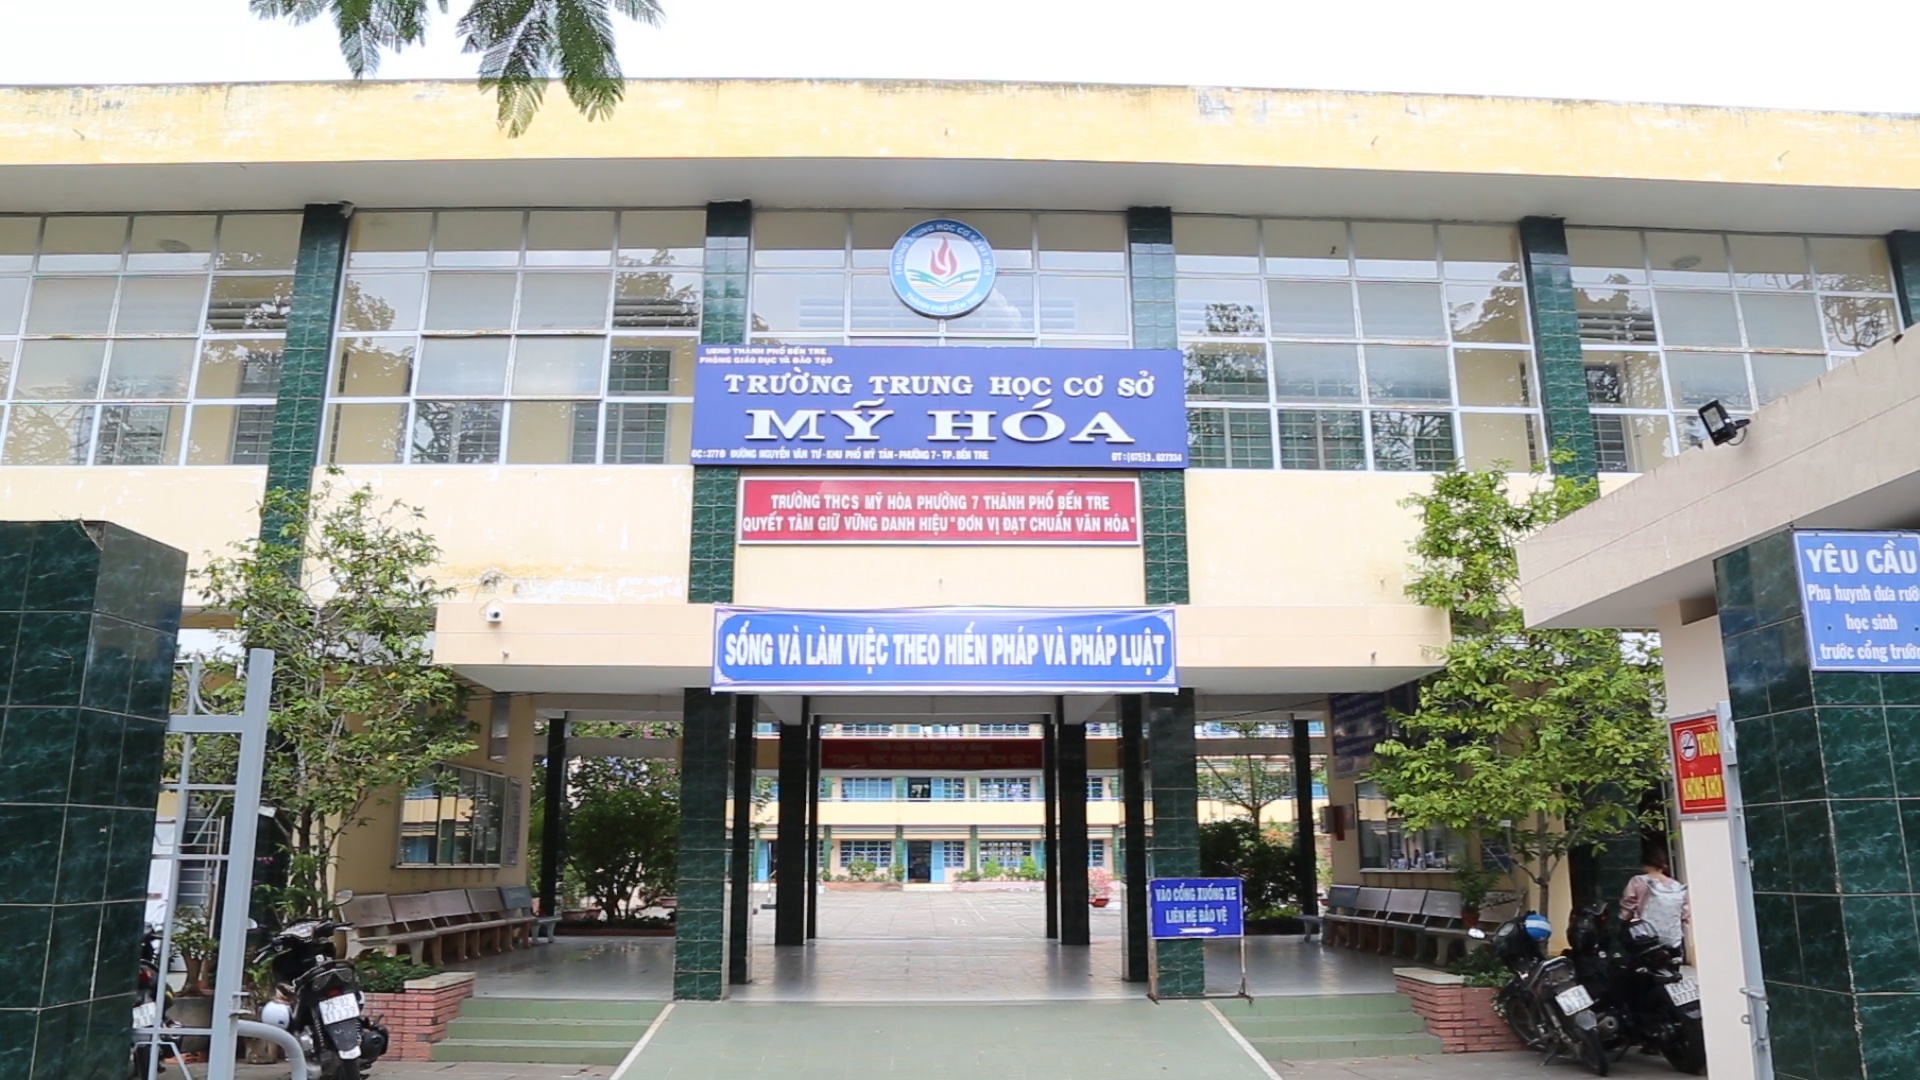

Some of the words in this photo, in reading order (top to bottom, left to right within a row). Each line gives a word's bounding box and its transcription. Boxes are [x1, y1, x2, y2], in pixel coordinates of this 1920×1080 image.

[732, 346, 764, 355] THÀNH
[766, 346, 786, 355] PHỐ
[808, 347, 827, 355] TRE
[733, 356, 756, 364] GIÁO
[814, 357, 833, 367] TẠO
[724, 367, 853, 395] TRƯỜNG
[868, 375, 974, 396] TRUNG
[989, 376, 1052, 402] HỌC
[1063, 374, 1104, 397] CƠ
[1117, 369, 1155, 397] SỞ
[744, 397, 895, 441] MỸ
[927, 398, 1136, 443] HÓA
[759, 446, 790, 459] NGUYỄN
[845, 446, 862, 459] PHỐ
[863, 448, 875, 459] MỸ
[973, 450, 989, 460] TRE
[771, 490, 821, 509] TRƯỜNG
[824, 494, 859, 510] THCS
[864, 492, 882, 510] MỸ
[917, 490, 967, 510] PHƯỜNG
[972, 495, 979, 510] 7
[983, 491, 1025, 510] THÀNH
[1028, 490, 1054, 510] PHỐ
[1057, 490, 1082, 510] BẾN
[1086, 495, 1110, 510] TRE
[743, 511, 784, 531] QUYẾT
[788, 512, 814, 531] TÂM
[817, 512, 840, 531] GIỮ
[844, 512, 878, 531] VỮNG
[881, 516, 915, 531] DANH
[919, 513, 948, 535] HIỆU
[987, 516, 999, 535] VỊ
[1003, 516, 1027, 535] ĐẠT
[1029, 511, 1072, 532] CHUẨN
[1075, 513, 1101, 531] VĂN
[1805, 542, 1859, 574] YÊU
[1866, 540, 1918, 574] CẦU
[1807, 583, 1831, 604] Phụ
[1833, 584, 1872, 604] huynh
[1873, 584, 1896, 602] đưa
[1844, 613, 1869, 634] học
[1871, 613, 1898, 630] sinh
[725, 620, 773, 666] SỐNG
[778, 625, 802, 665] VÀ
[806, 625, 843, 665] LÀM
[847, 627, 889, 674] VIỆC
[892, 633, 941, 666] THEO
[944, 622, 987, 666] HIẾN
[991, 626, 1039, 666] PHÁP
[1042, 626, 1067, 666] VÀ
[1070, 626, 1117, 666] PHÁP
[1121, 627, 1165, 676] LUẬT
[1820, 642, 1855, 660] trước
[1857, 639, 1889, 663] cổng
[1155, 884, 1172, 902] VÀO
[1172, 882, 1196, 901] CỔNG
[1196, 883, 1224, 901] XUỐNG
[1225, 887, 1237, 900] XE
[1165, 906, 1185, 924] LIÊN
[1185, 906, 1198, 926] HỆ
[1198, 904, 1216, 922] BẢO
[1216, 905, 1228, 926] VỆ
